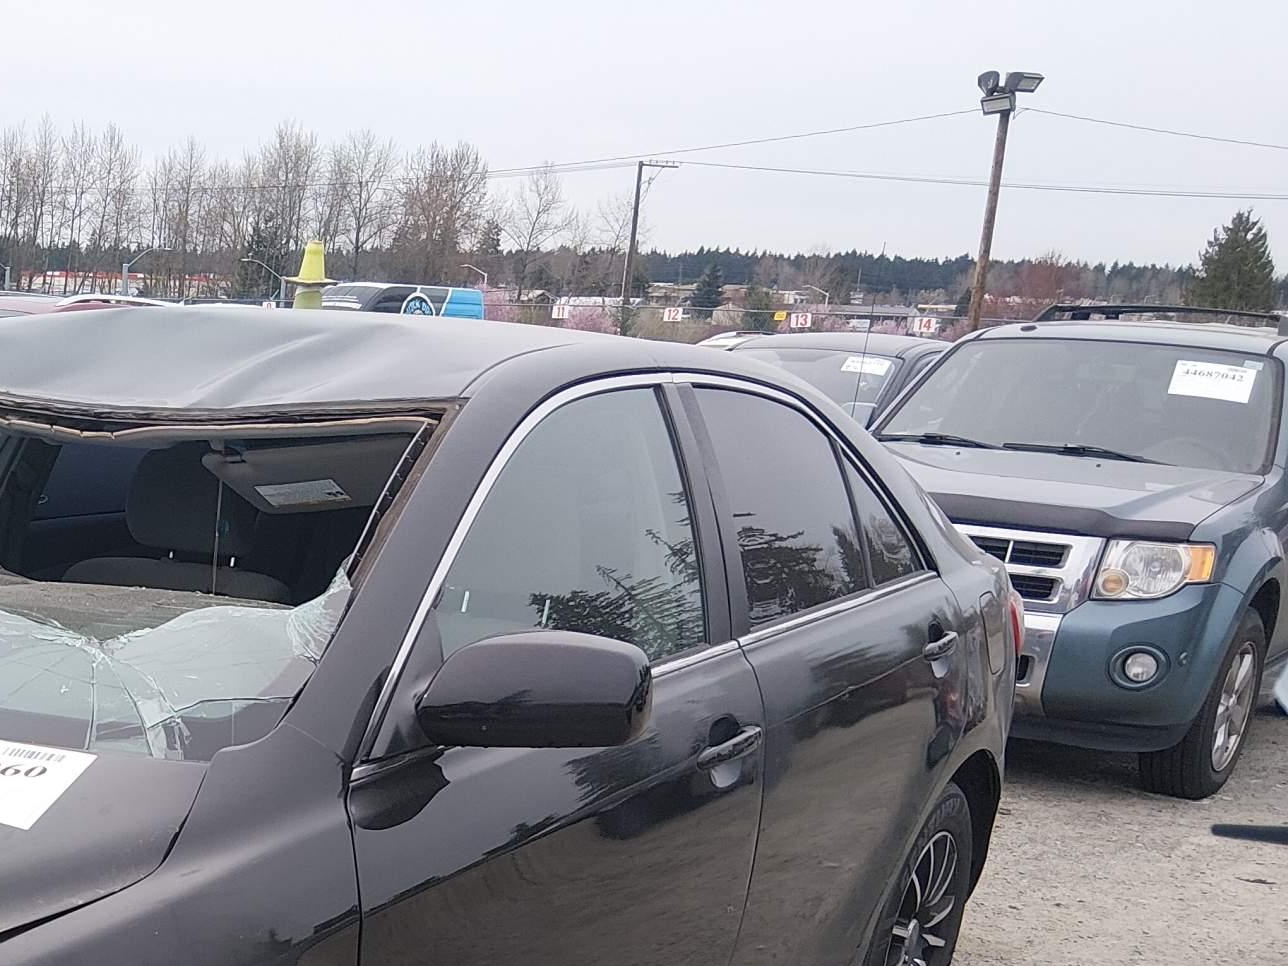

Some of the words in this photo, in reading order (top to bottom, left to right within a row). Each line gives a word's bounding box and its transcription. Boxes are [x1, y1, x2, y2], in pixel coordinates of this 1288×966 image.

[667, 308, 679, 321] 12
[795, 313, 808, 327] 13
[918, 318, 932, 331] 14
